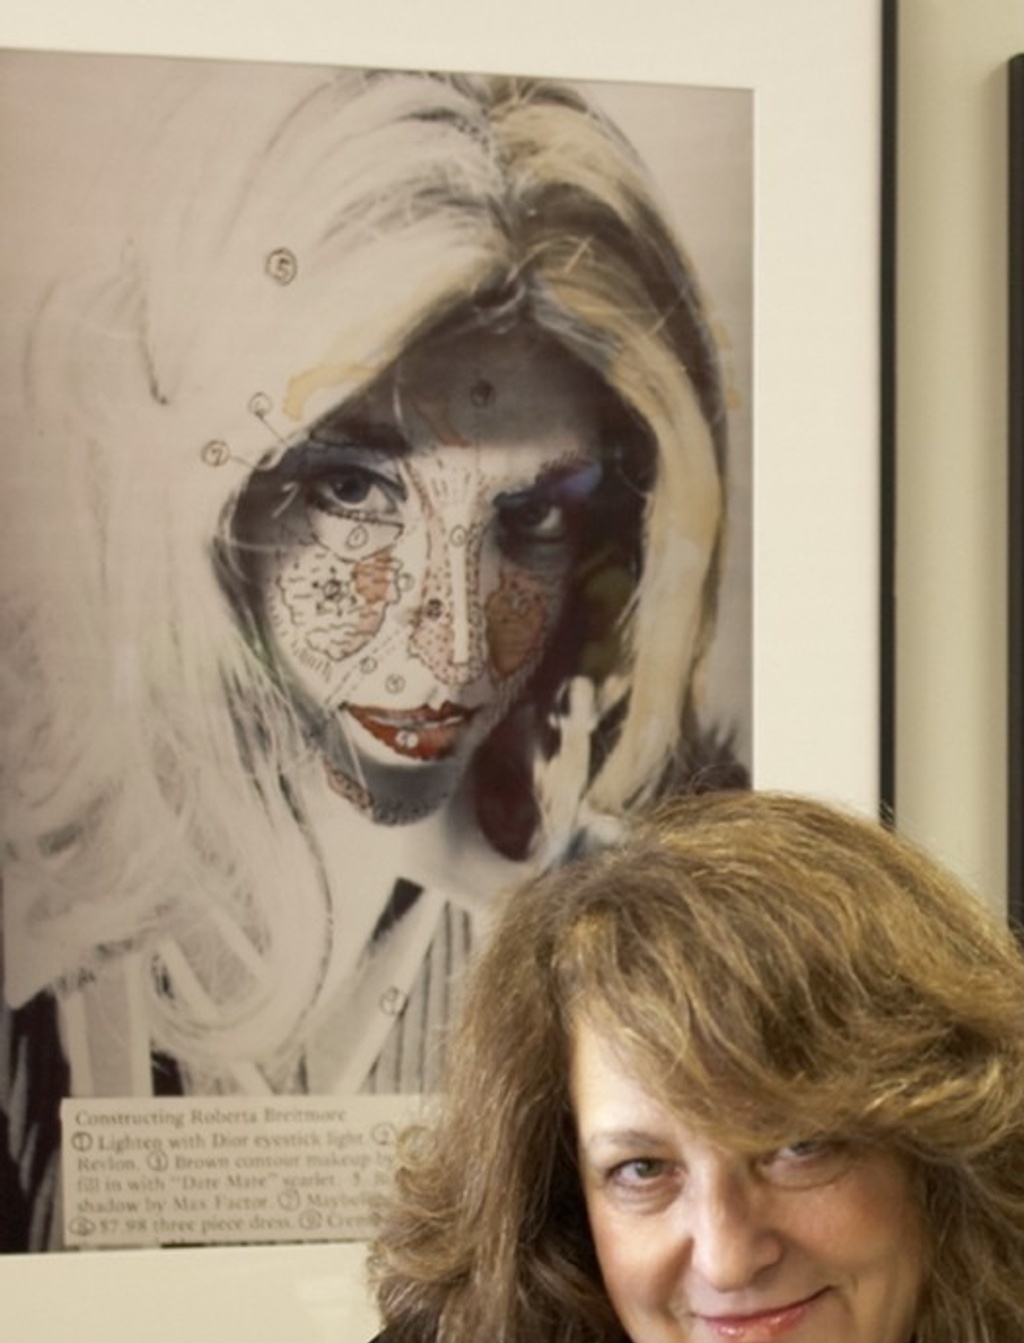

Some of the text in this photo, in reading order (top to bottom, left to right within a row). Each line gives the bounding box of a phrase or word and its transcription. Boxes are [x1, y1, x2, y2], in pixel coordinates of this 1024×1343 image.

[76, 1110, 184, 1128] Constructing
[191, 1107, 257, 1124] Roberta
[99, 1135, 162, 1154] Lighten
[175, 1155, 229, 1169] Brown
